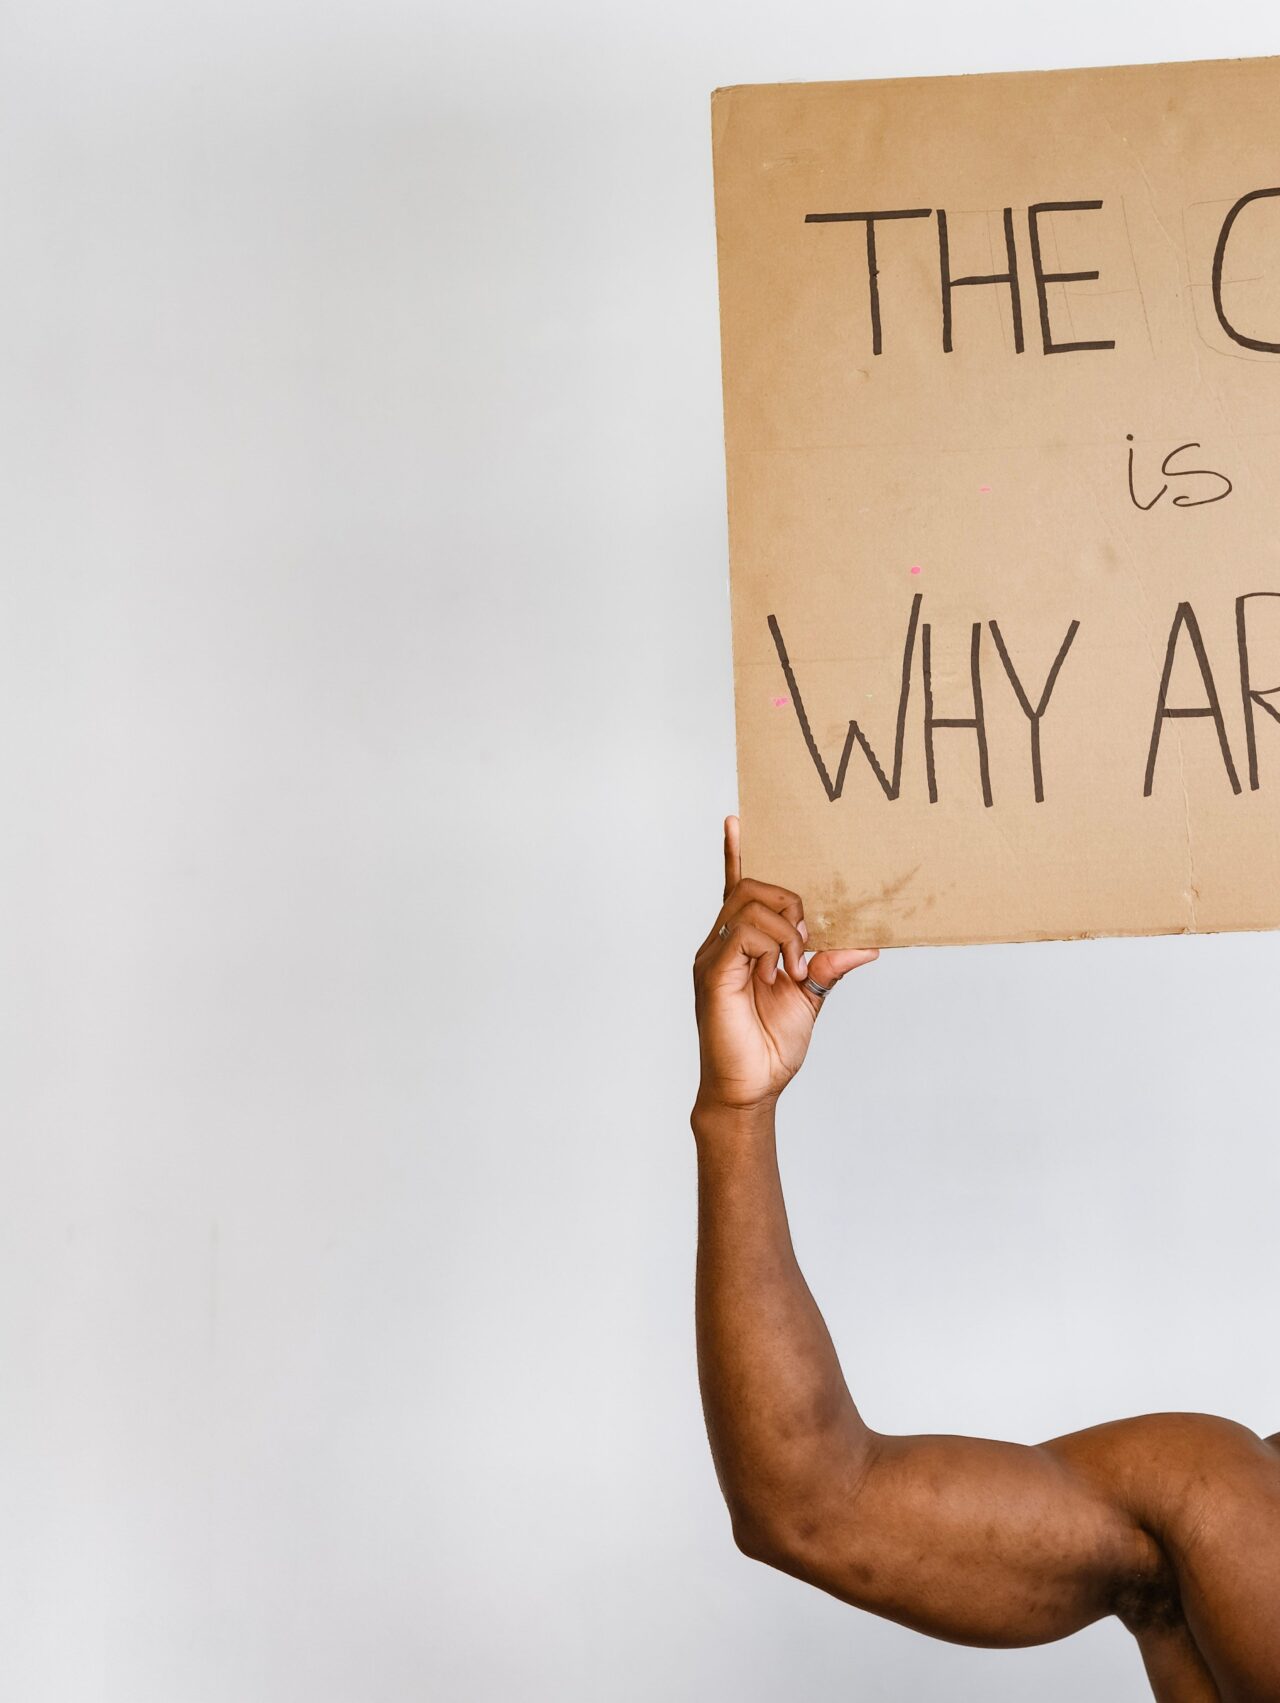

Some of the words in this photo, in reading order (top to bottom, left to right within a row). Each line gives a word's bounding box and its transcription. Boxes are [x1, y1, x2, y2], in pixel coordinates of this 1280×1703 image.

[804, 199, 1117, 356] THE
[1125, 433, 1233, 511] is
[766, 592, 1081, 808] WHY
